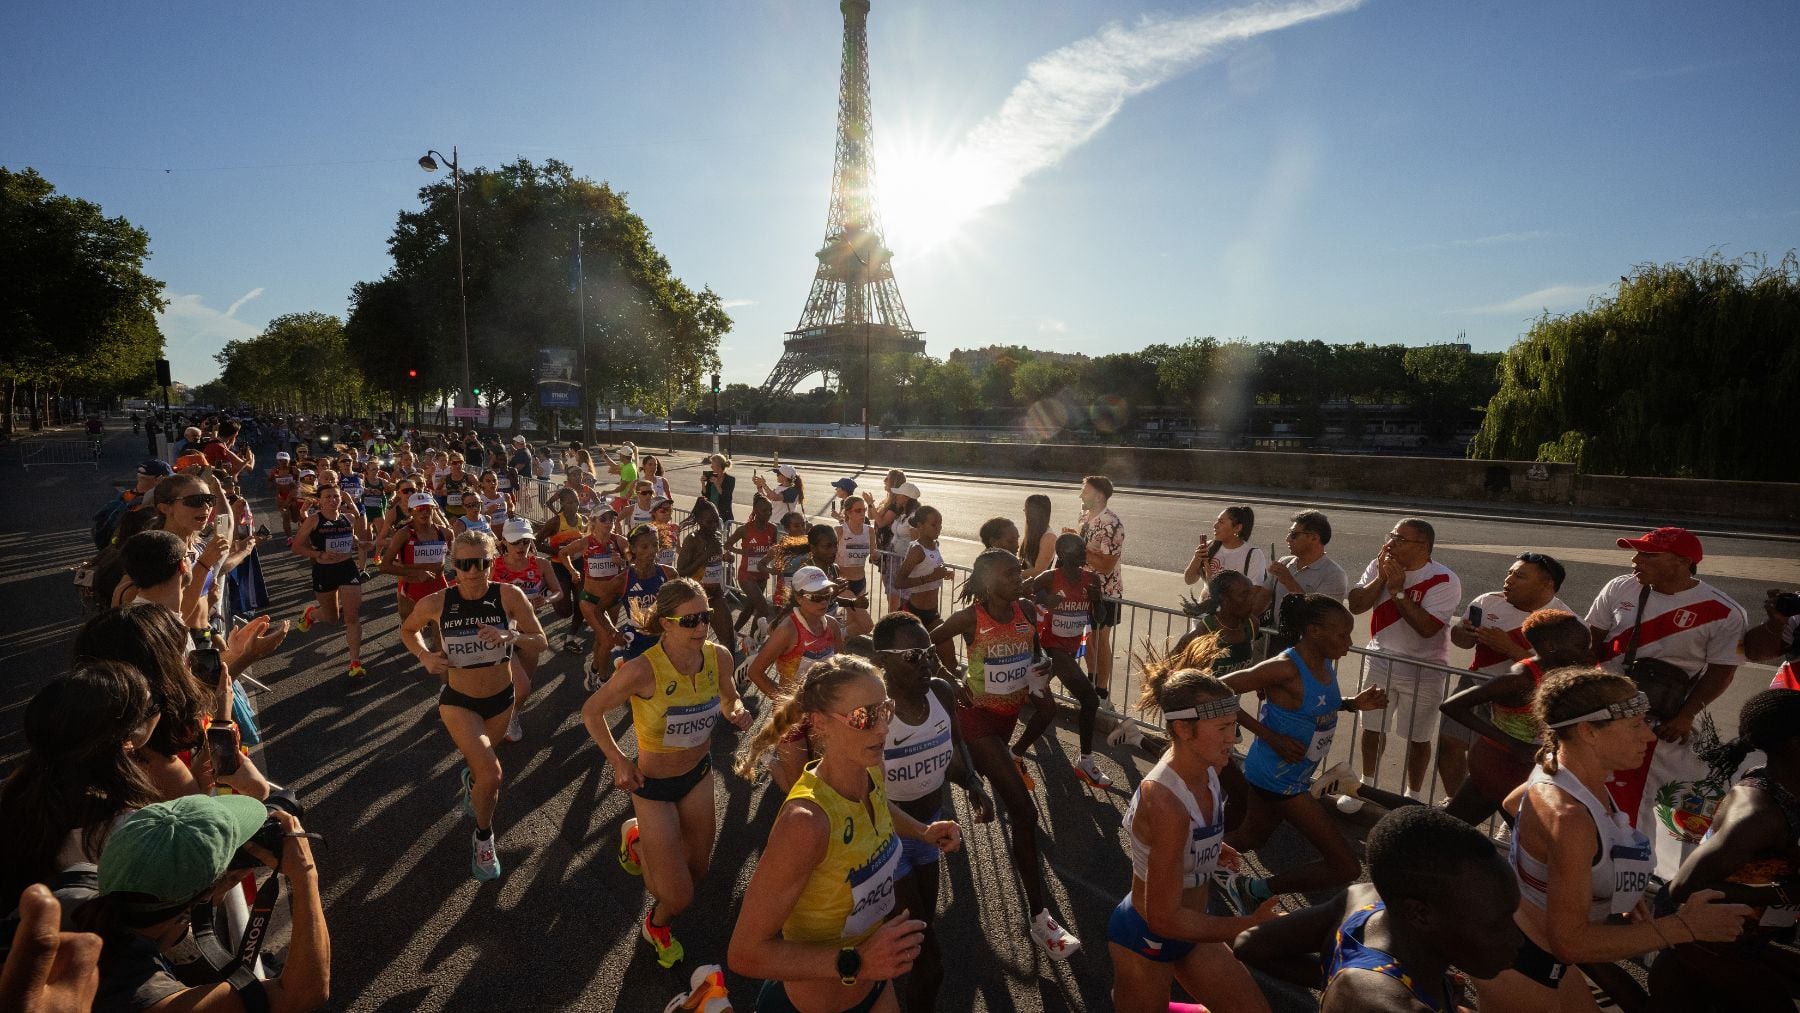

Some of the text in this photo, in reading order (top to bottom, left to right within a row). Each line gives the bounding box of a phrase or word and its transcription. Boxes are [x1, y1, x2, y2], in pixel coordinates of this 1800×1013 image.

[589, 562, 616, 570] CRISTIA
[1054, 601, 1090, 611] AHRAIN
[444, 615, 501, 629] NEW ZEALAND
[987, 641, 1029, 657] KENYA
[989, 665, 1029, 683] LOKED
[888, 750, 952, 782] SALPETER
[242, 917, 265, 964] SONY
